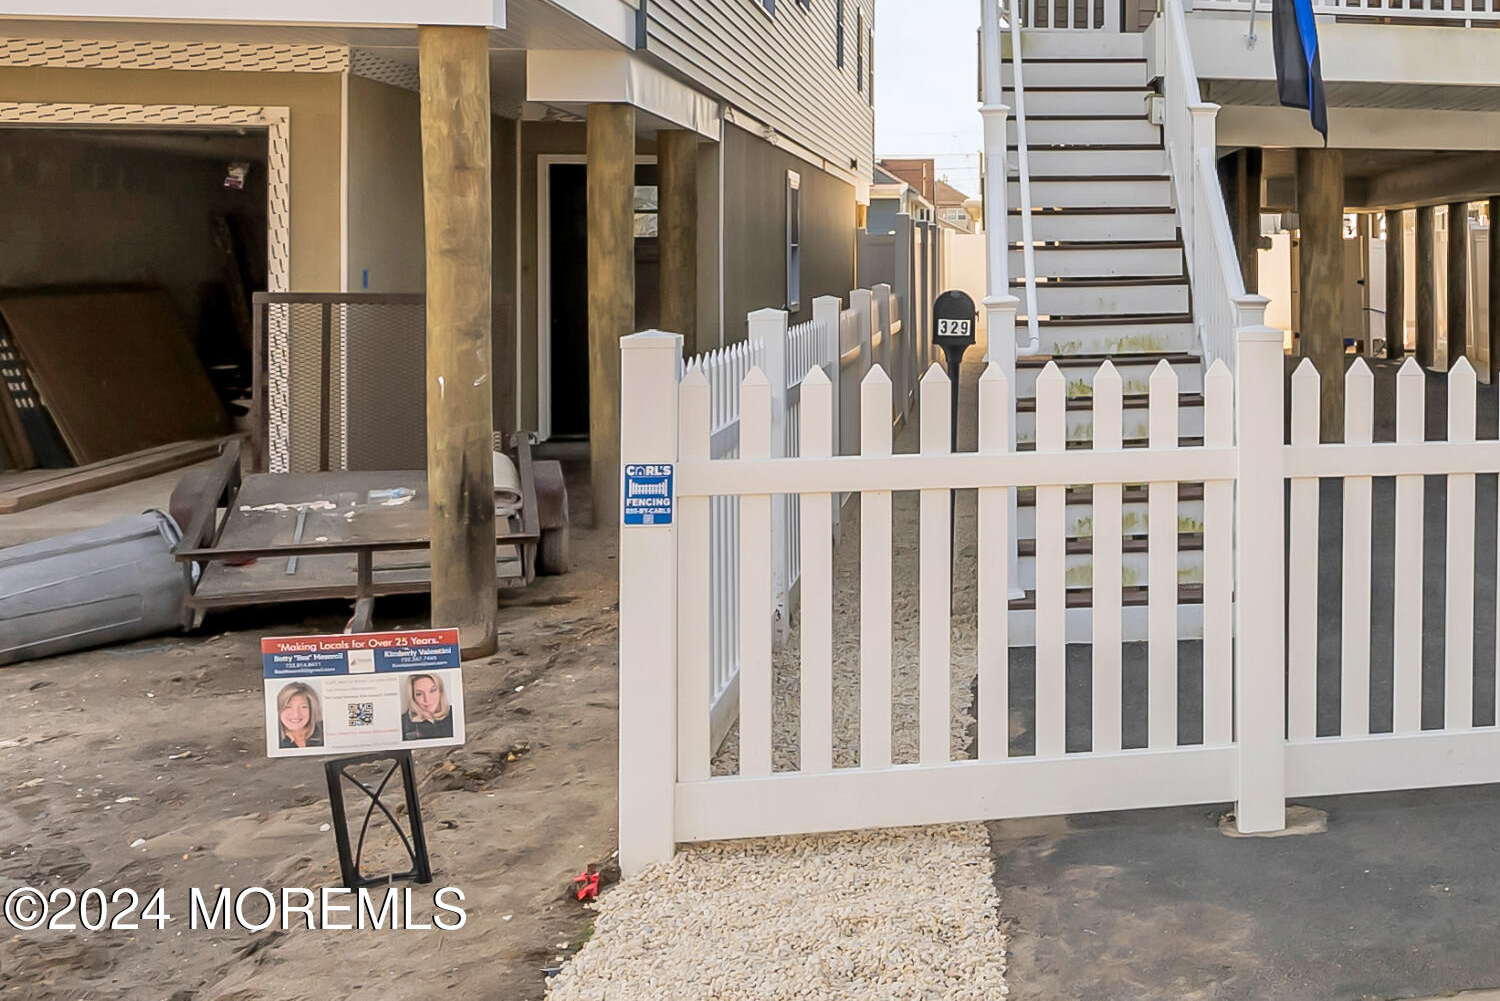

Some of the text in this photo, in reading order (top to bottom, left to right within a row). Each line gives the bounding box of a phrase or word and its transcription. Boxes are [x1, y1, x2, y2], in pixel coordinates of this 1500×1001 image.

[940, 320, 968, 334] 329
[626, 466, 671, 475] CARL'S
[626, 498, 670, 506] FENCING
[277, 635, 443, 652] "Making Locals for Over 25 Years."
